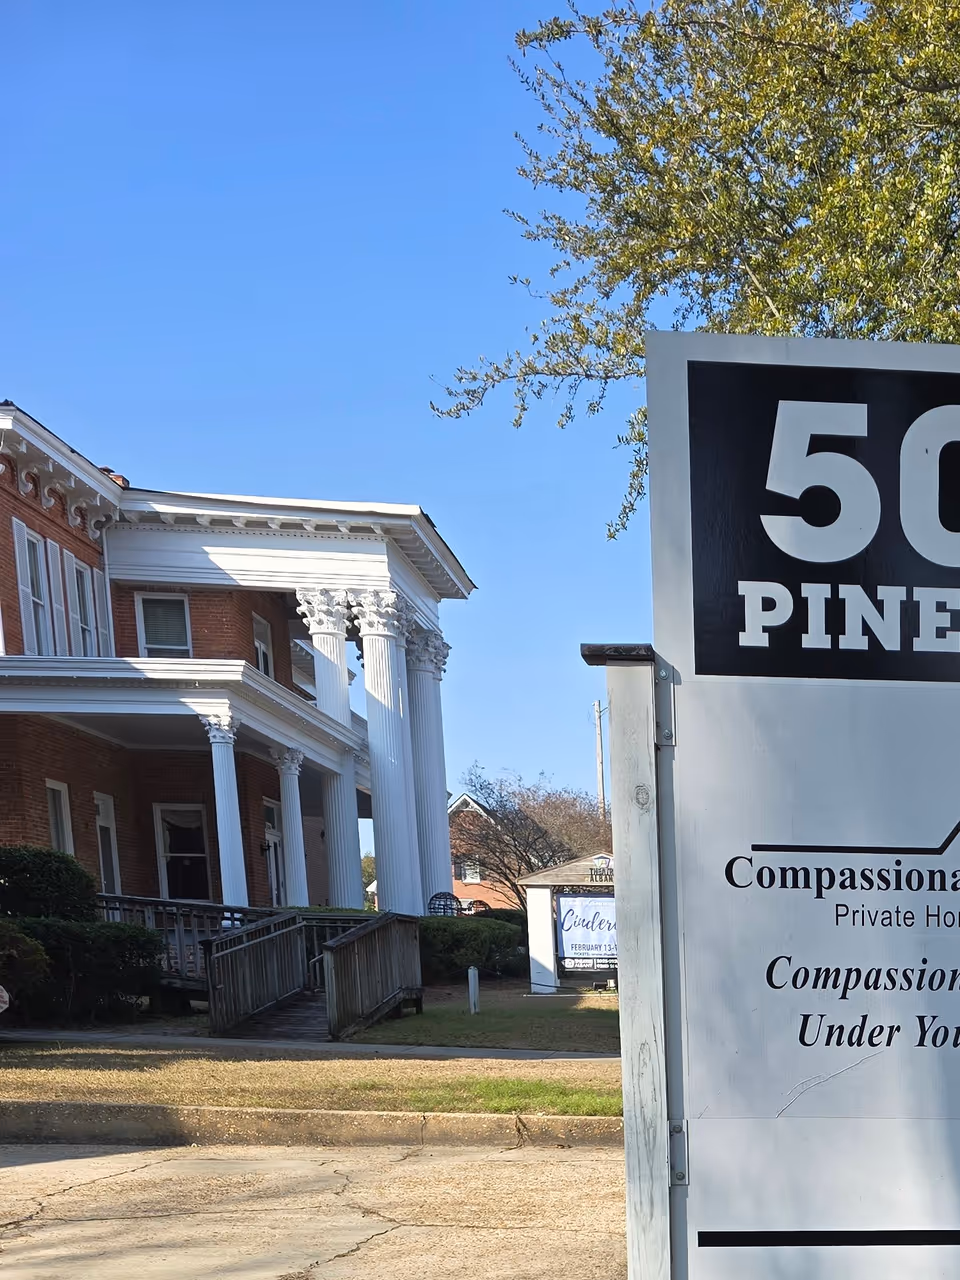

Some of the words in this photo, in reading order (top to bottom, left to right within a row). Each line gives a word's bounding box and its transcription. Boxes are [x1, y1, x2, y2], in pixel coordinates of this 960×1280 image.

[835, 903, 915, 928] Private
[570, 943, 602, 952] FEBRUARY
[798, 1013, 901, 1048] Under
